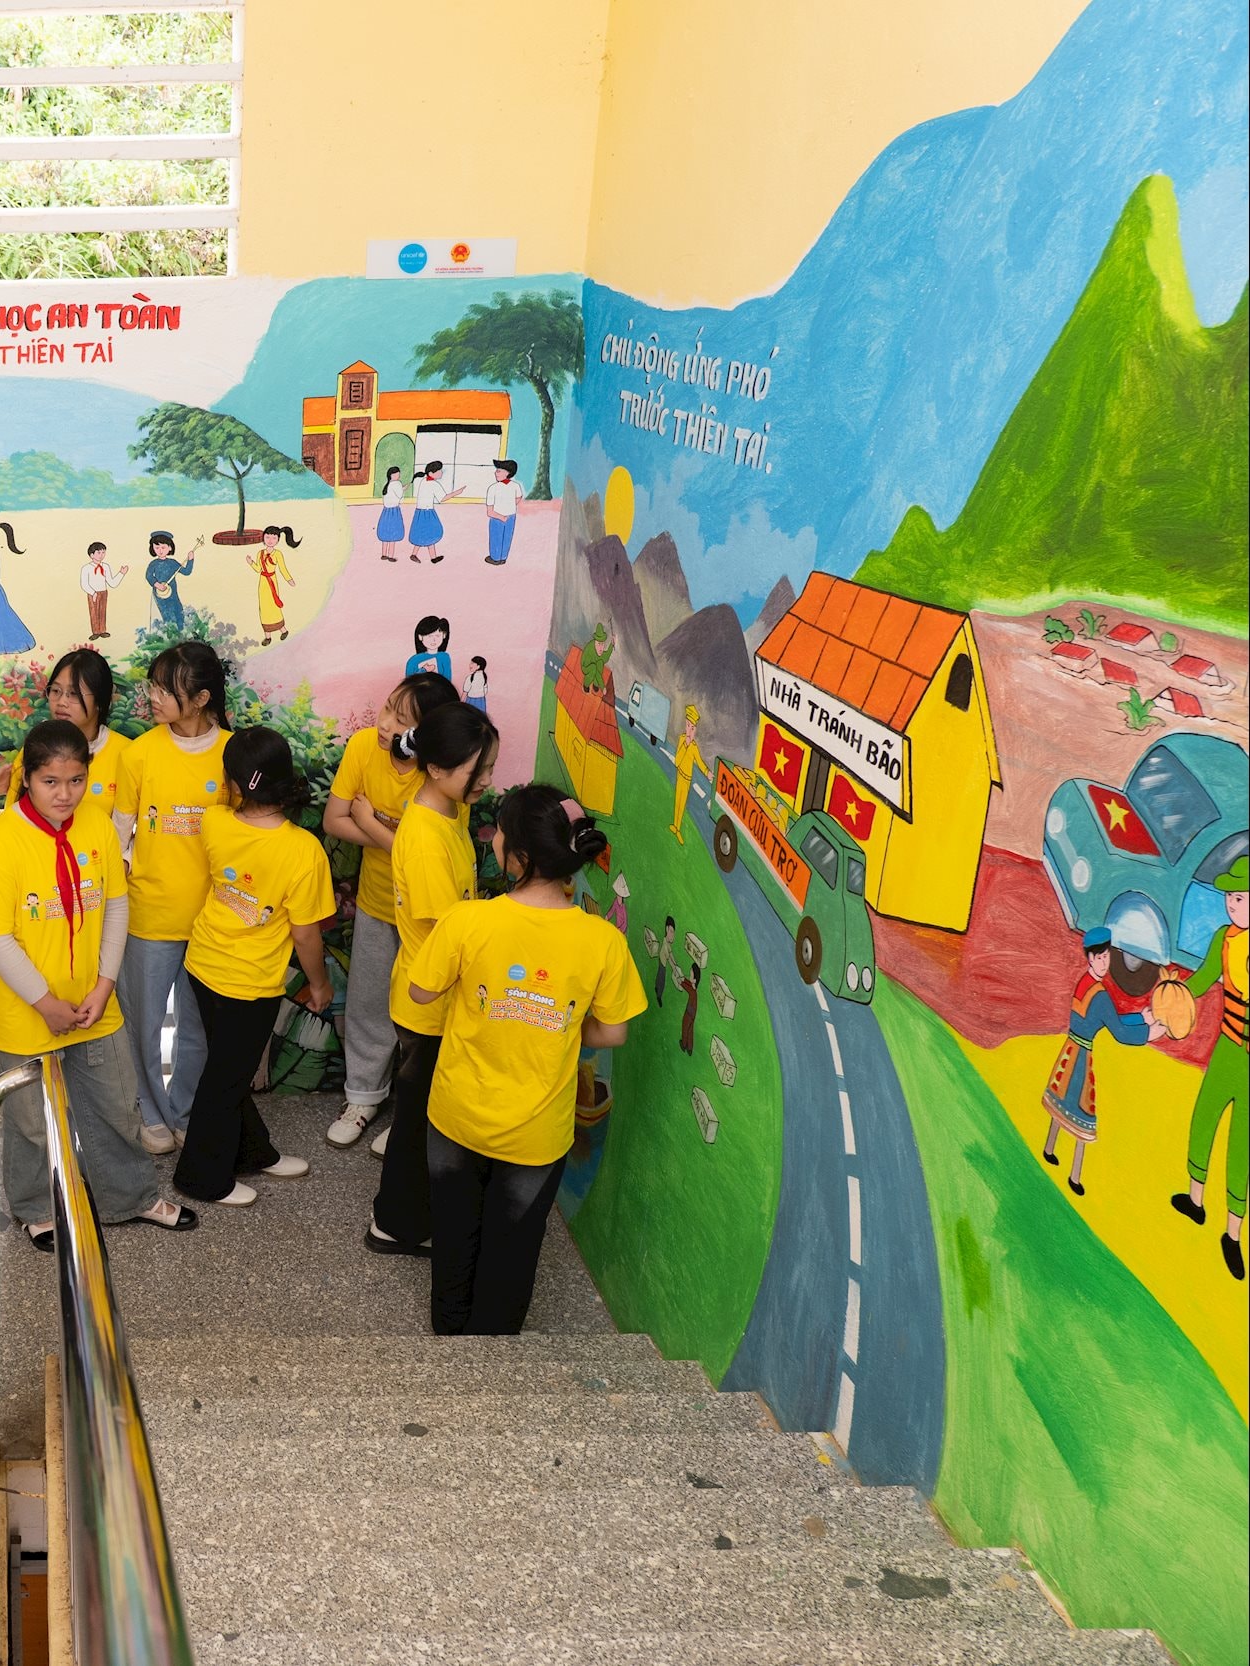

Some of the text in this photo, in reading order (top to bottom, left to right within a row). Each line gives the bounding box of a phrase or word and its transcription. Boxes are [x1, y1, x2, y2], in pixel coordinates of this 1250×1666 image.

[46, 303, 89, 331] AN
[95, 292, 181, 331] TOÀN
[633, 332, 680, 385] ĐỘNG
[683, 326, 722, 391] ỨNG
[725, 346, 780, 402] PHÓ
[620, 383, 670, 436] TRƯỚC
[673, 403, 729, 456] THIÊN
[770, 677, 902, 781] NHÀ TRÁNH BÃO
[720, 773, 748, 819] ĐOÀN
[770, 834, 798, 887] TRỢ
